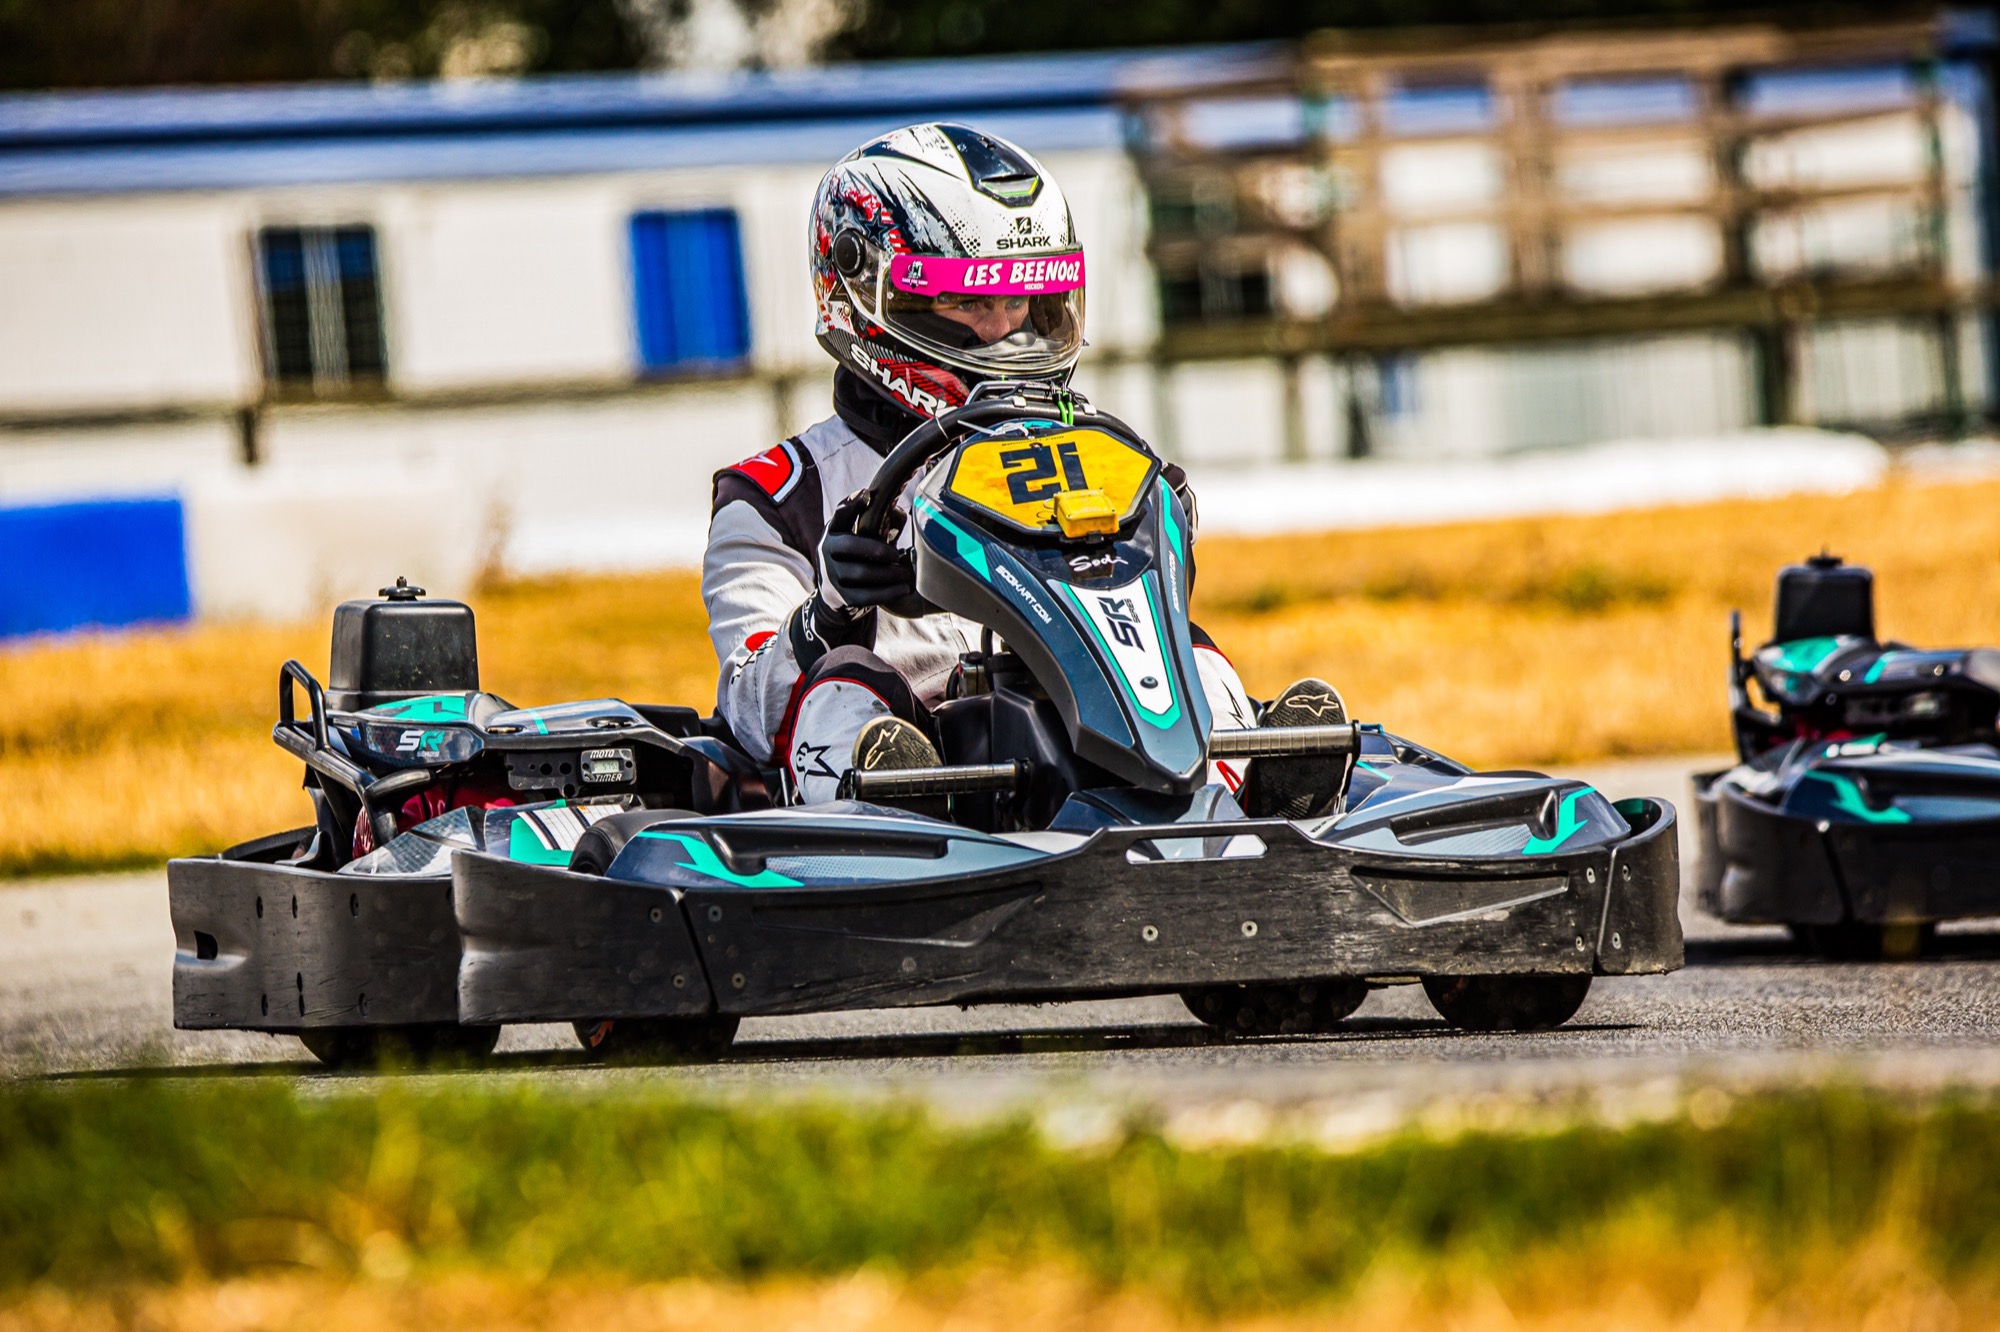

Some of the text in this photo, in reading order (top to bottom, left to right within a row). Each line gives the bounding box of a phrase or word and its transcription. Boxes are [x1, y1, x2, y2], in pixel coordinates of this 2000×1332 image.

[996, 236, 1051, 250] SHARK
[963, 263, 1002, 287] LES
[999, 442, 1088, 505] 21
[1069, 554, 1129, 572] Sodi
[995, 564, 1052, 624] SODIKART.COM
[1097, 596, 1146, 653] SR
[395, 730, 446, 751] SR
[590, 749, 615, 758] MOTO
[595, 773, 622, 782] TIMER
